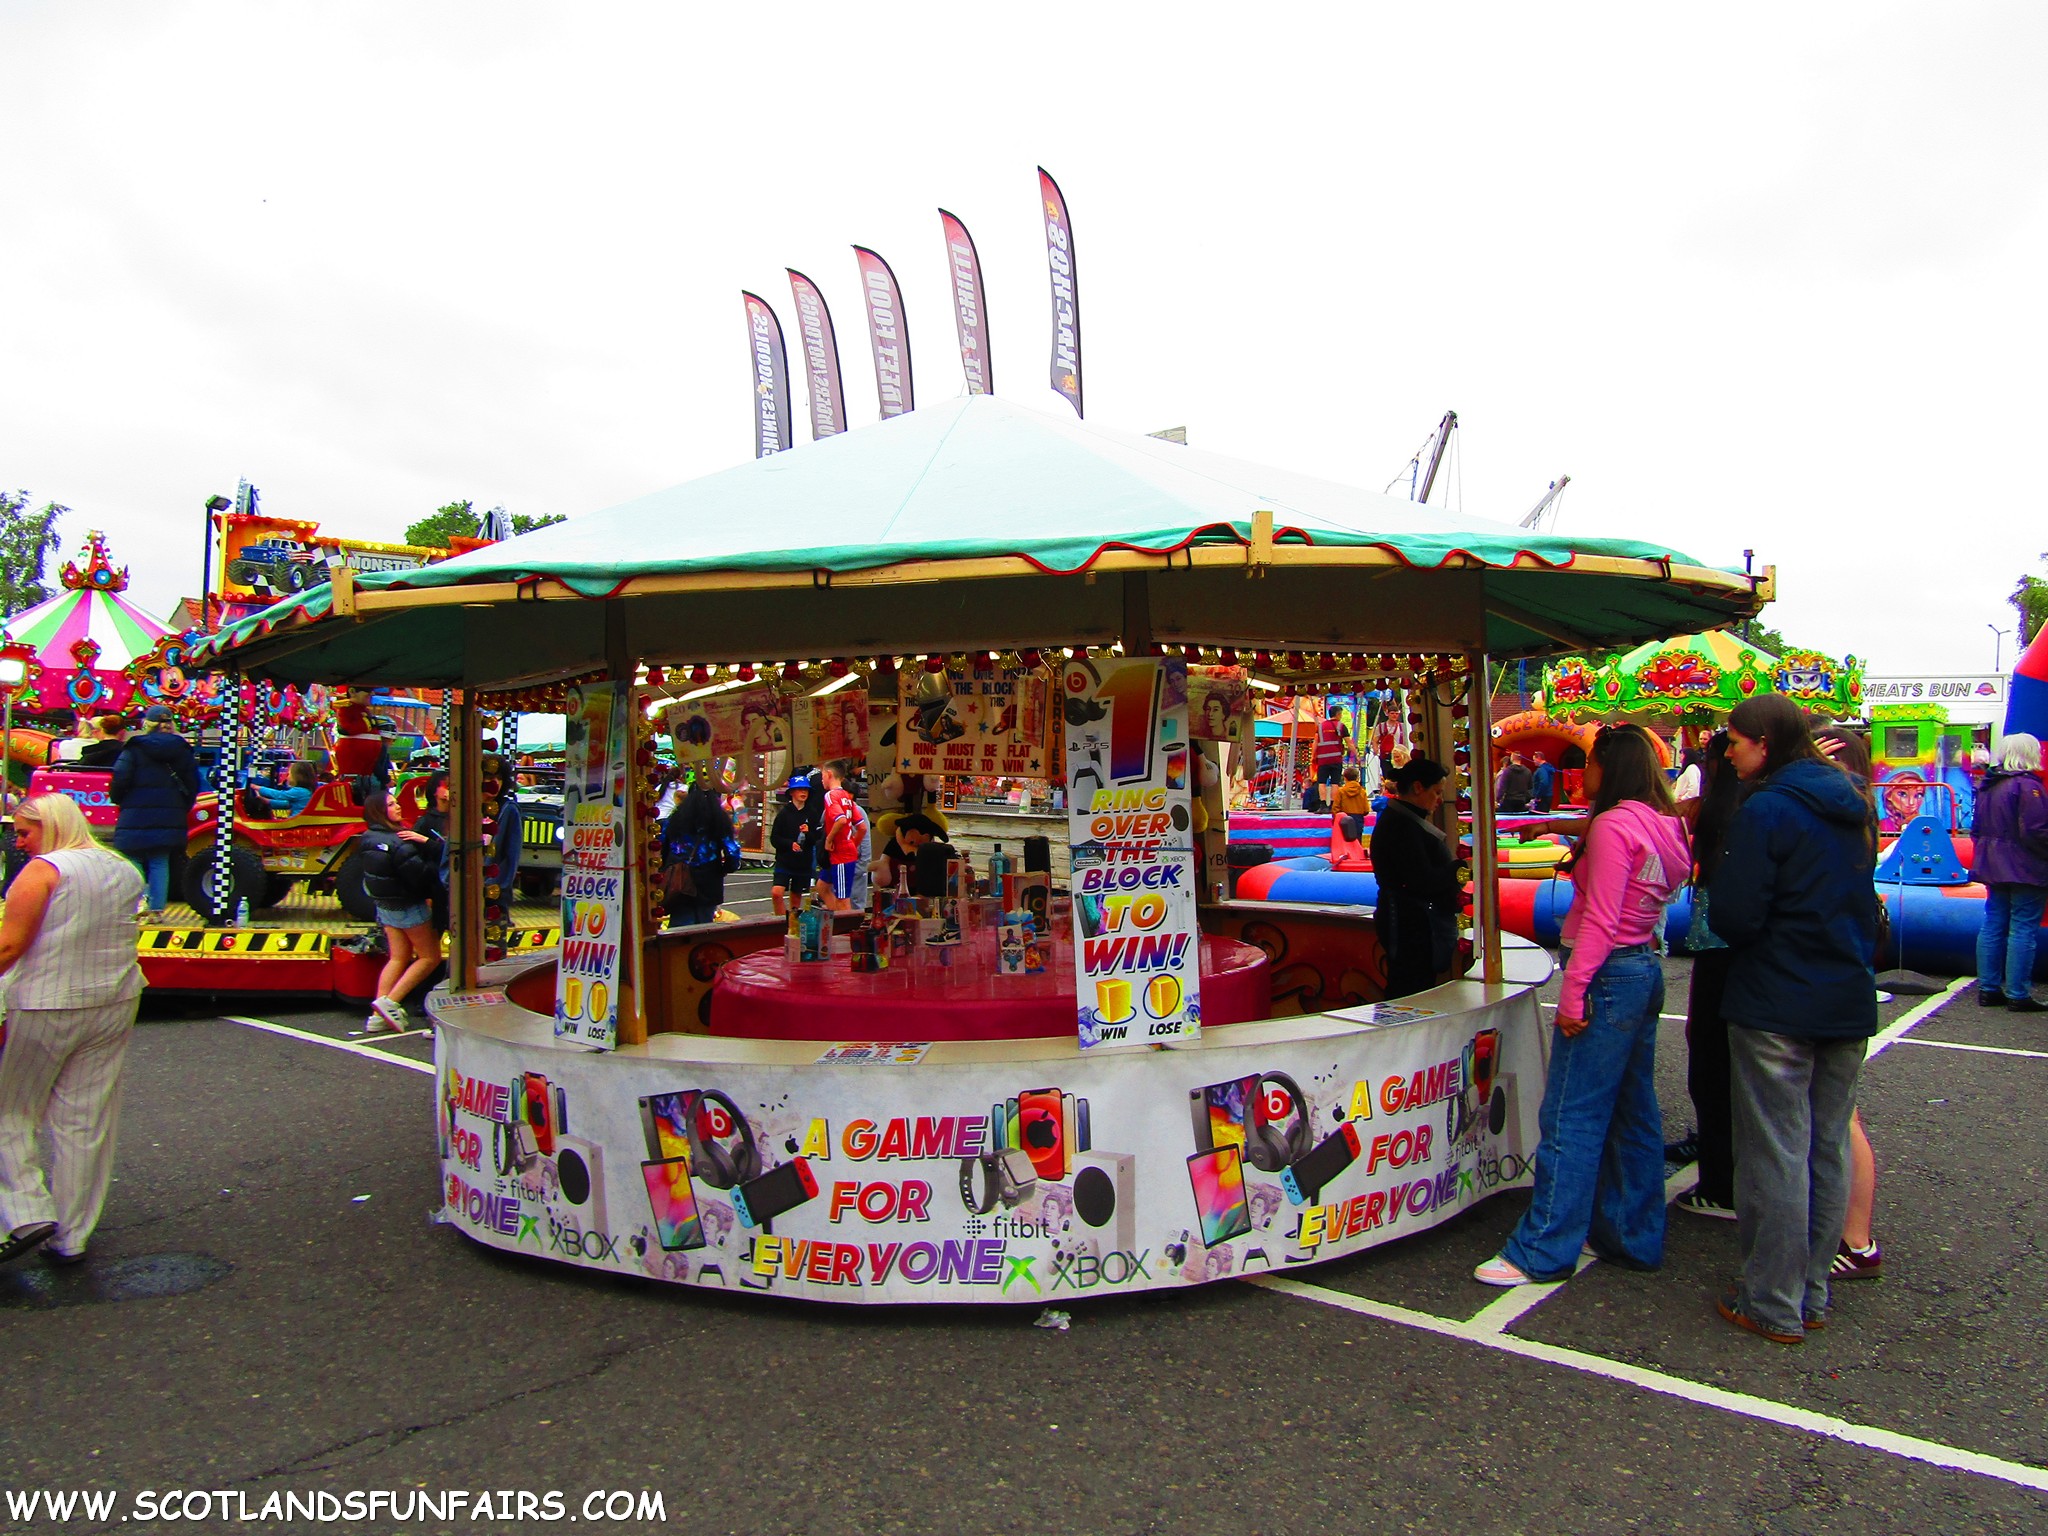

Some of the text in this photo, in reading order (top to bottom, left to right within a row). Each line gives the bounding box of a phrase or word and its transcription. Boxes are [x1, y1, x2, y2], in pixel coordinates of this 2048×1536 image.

[955, 682, 973, 695] THE
[990, 697, 1005, 707] THIS
[1863, 682, 1971, 697] MEATS BUN
[913, 742, 1031, 757] RING MUST BE FLAT
[919, 758, 1024, 772] ON TABLE TO WIN
[1089, 787, 1168, 815] RING
[574, 804, 614, 827] RING
[1090, 812, 1173, 840] OVER
[573, 828, 615, 851] OVER
[1104, 838, 1163, 866] THE
[578, 852, 609, 874] THE
[566, 875, 619, 901] BLOCK
[1081, 864, 1186, 895] BLOCK
[575, 901, 609, 938] TO
[1103, 892, 1169, 933] TO
[562, 939, 618, 979] WIN!
[1083, 933, 1191, 977] WIN!
[564, 1020, 578, 1035] WIN
[587, 1025, 607, 1041] LOSE
[1101, 1026, 1128, 1041] WIN
[1149, 1021, 1183, 1036] LOSE
[1347, 1057, 1461, 1122] A GAME
[799, 1115, 989, 1162] A GAME
[1366, 1122, 1434, 1175] FOR
[1454, 1135, 1478, 1160] fitbit
[1477, 1151, 1536, 1193] XBOX
[510, 1178, 546, 1205] fitbit
[828, 1179, 934, 1224] FOR
[1299, 1162, 1461, 1250] EVERYONE
[993, 1215, 1051, 1239] fitbit
[550, 1222, 621, 1264] XBOX
[752, 1236, 1008, 1287] EVERYONE
[1051, 1247, 1152, 1292] XBOX
